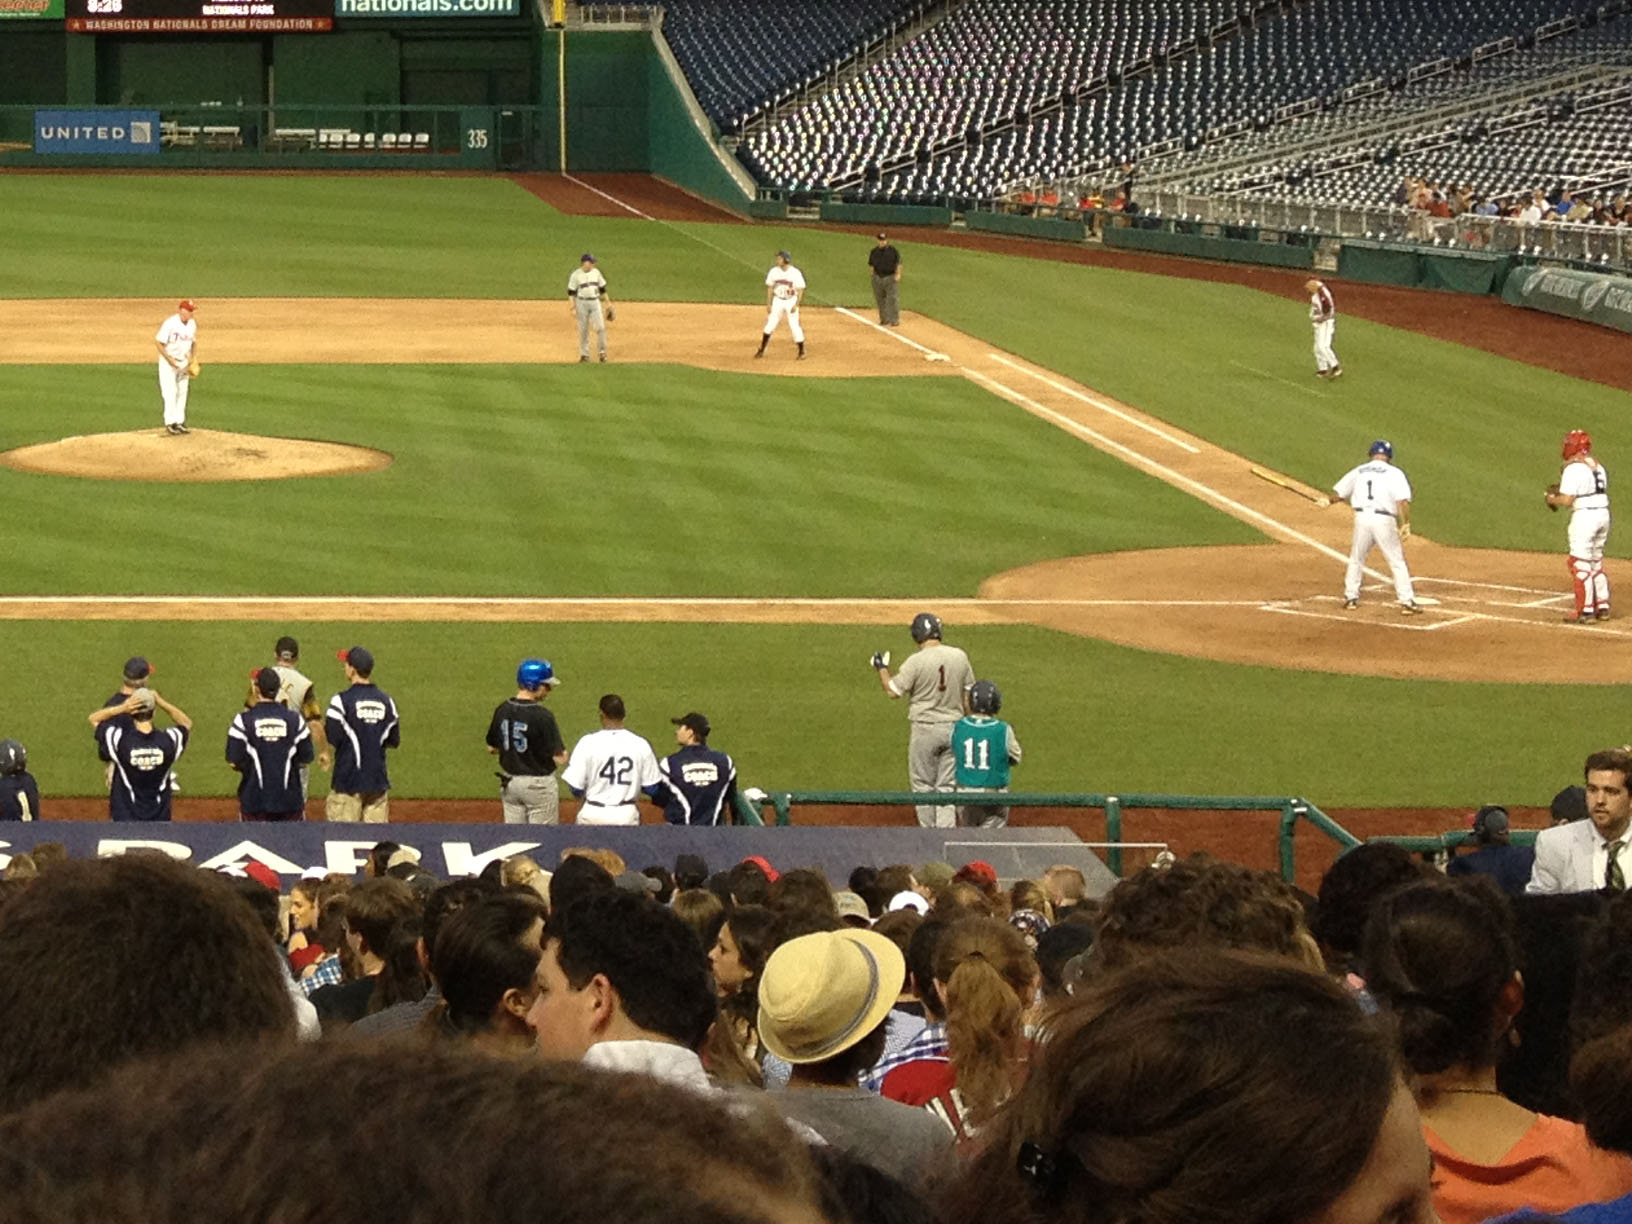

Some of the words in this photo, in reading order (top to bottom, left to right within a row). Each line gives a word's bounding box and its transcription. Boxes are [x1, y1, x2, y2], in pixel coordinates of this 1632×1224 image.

[203, 4, 249, 16] NATIONALS
[250, 4, 275, 15] PARK
[86, 19, 150, 30] WASHINGTON
[153, 19, 207, 30] NATIONALS
[249, 18, 313, 29] FOUNDATION
[41, 127, 126, 140] UNITED
[467, 129, 488, 149] 335
[938, 664, 947, 692] 1
[500, 719, 529, 753] 15
[963, 737, 990, 771] 11
[599, 756, 633, 786] 42
